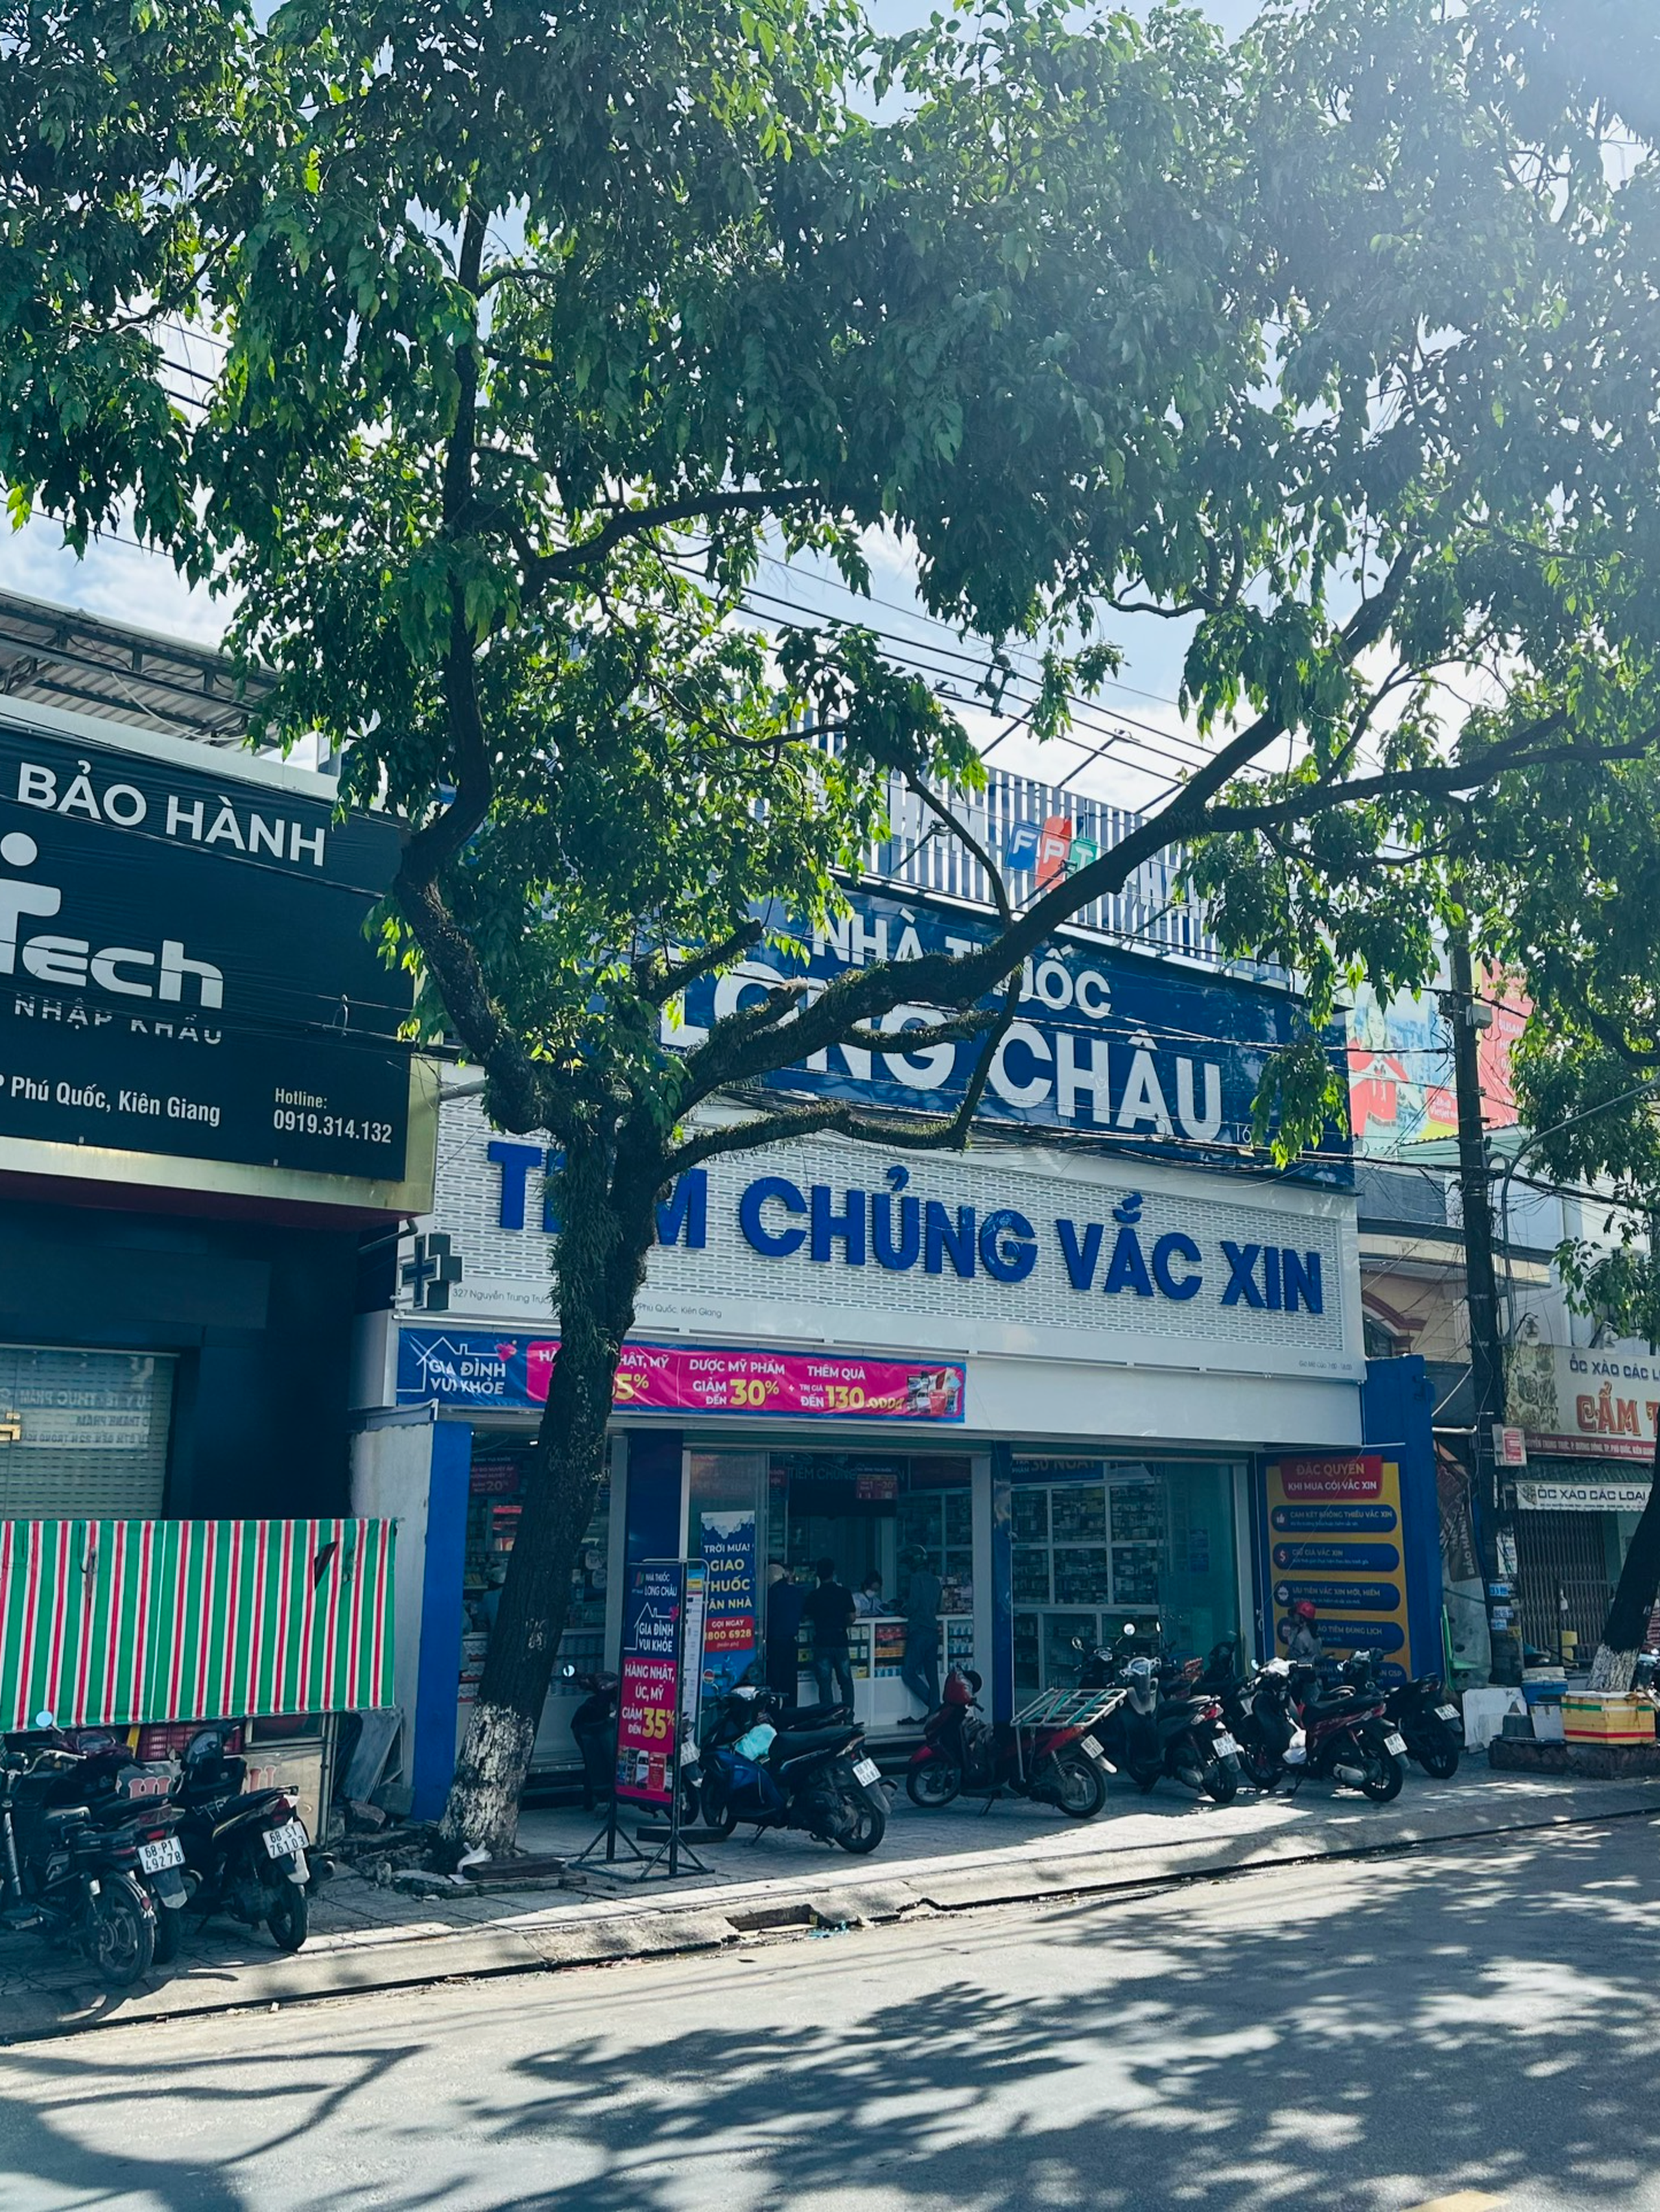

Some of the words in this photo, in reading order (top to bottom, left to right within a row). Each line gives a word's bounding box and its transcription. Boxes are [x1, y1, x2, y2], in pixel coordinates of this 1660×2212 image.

[18, 760, 147, 826] BẢO
[165, 795, 325, 866] HÀNH
[1012, 829, 1094, 872] FPT
[988, 1029, 1222, 1141] CHÂU
[11, 1075, 49, 1101] Phú
[56, 1082, 111, 1112] Quốc,
[119, 1090, 160, 1115] Kiên
[167, 1096, 220, 1127] Giang
[275, 1088, 327, 1109] Hotline:
[274, 1110, 392, 1144] 0919.314.132
[488, 1141, 707, 1249] TIM
[739, 1165, 1038, 1282] CHỦNG
[1056, 1192, 1202, 1300] VẮC
[1220, 1240, 1323, 1314] XIN
[453, 1288, 468, 1297] 327
[469, 1289, 504, 1300] Nguyễn
[506, 1292, 530, 1304] Trung
[681, 1306, 697, 1315] Kiên
[699, 1308, 722, 1319] Giang
[428, 1359, 456, 1376] GIA
[460, 1358, 506, 1378] ĐÌNH
[620, 1352, 647, 1369] HẬT,
[689, 1358, 725, 1374] DƯỢC
[728, 1358, 749, 1372] MỸ
[751, 1360, 785, 1375] PHẨM
[1592, 1359, 1620, 1376] XÀO
[1624, 1363, 1648, 1379] CÁC
[807, 1365, 840, 1380] THÊM
[842, 1366, 866, 1380] QUÀ
[431, 1378, 456, 1392] VUI
[461, 1377, 504, 1394] KHỎE
[613, 1373, 649, 1400] 5%
[693, 1377, 726, 1393] GIẢM
[729, 1378, 779, 1406] 30%
[705, 1392, 727, 1406] ĐẾN
[800, 1393, 824, 1407] ĐẾN
[1576, 1381, 1641, 1436] CẨM
[1323, 1460, 1364, 1476] QUYỀN
[1304, 1482, 1323, 1490] MUA
[1325, 1479, 1340, 1490] GÓI
[1342, 1479, 1358, 1490] VẮC
[1559, 1487, 1586, 1500] XÀO
[1590, 1487, 1616, 1500] CÁC
[1618, 1491, 1646, 1504] LOẠI
[704, 1543, 725, 1553] TRỜI
[728, 1542, 750, 1553] MƯA!
[710, 1559, 744, 1571] GIAO
[728, 1595, 752, 1608] NHÀ
[639, 1622, 652, 1636] GIA
[654, 1619, 674, 1637] ĐÌNH
[711, 1621, 724, 1629] GỌI
[726, 1619, 745, 1628] NGAY
[729, 1629, 752, 1639] 6928
[639, 1638, 650, 1651] VUI
[652, 1636, 672, 1653] KHỎE
[624, 1661, 648, 1678] HÀNG
[650, 1664, 674, 1684] NHẬT,
[635, 1682, 649, 1702] ÚC,
[650, 1684, 664, 1701] MỸ
[622, 1703, 643, 1721] GIẢM
[628, 1723, 641, 1735] ĐẾN
[642, 1707, 675, 1740] 35%
